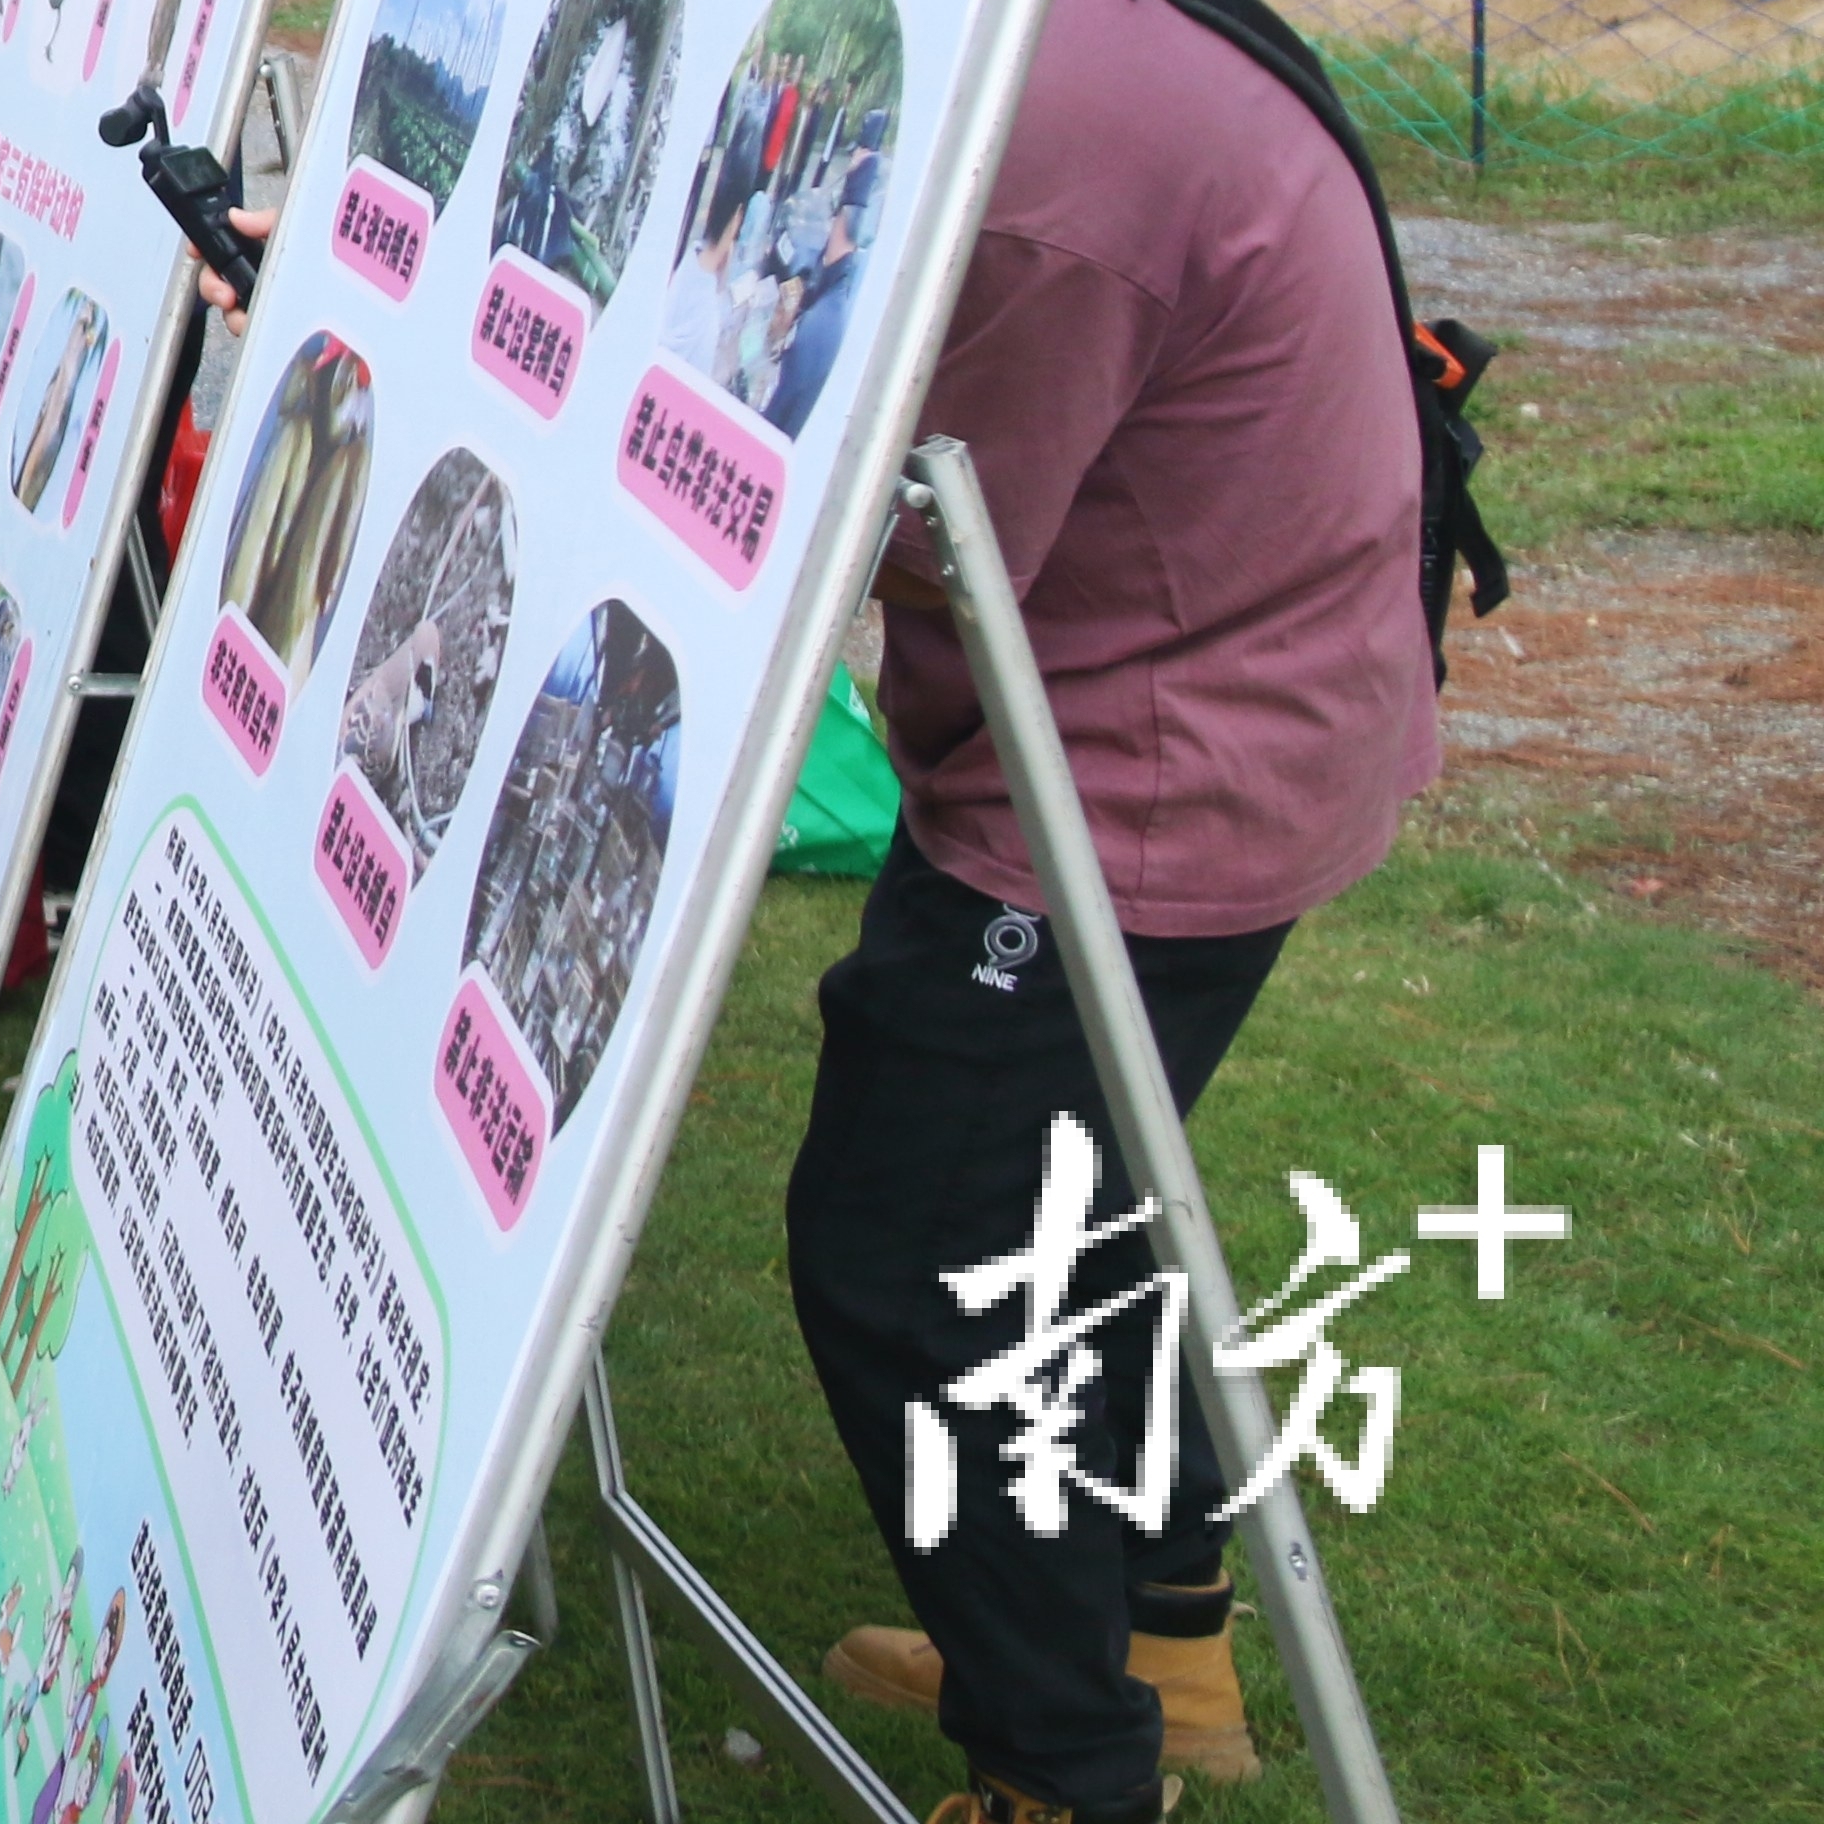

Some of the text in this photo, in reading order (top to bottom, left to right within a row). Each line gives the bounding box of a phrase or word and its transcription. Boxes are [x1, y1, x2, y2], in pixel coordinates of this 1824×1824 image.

[625, 392, 774, 564] 禁止鸟类非法交易
[971, 962, 1018, 992] NINE
[443, 1006, 534, 1206] 禁止非法运输
